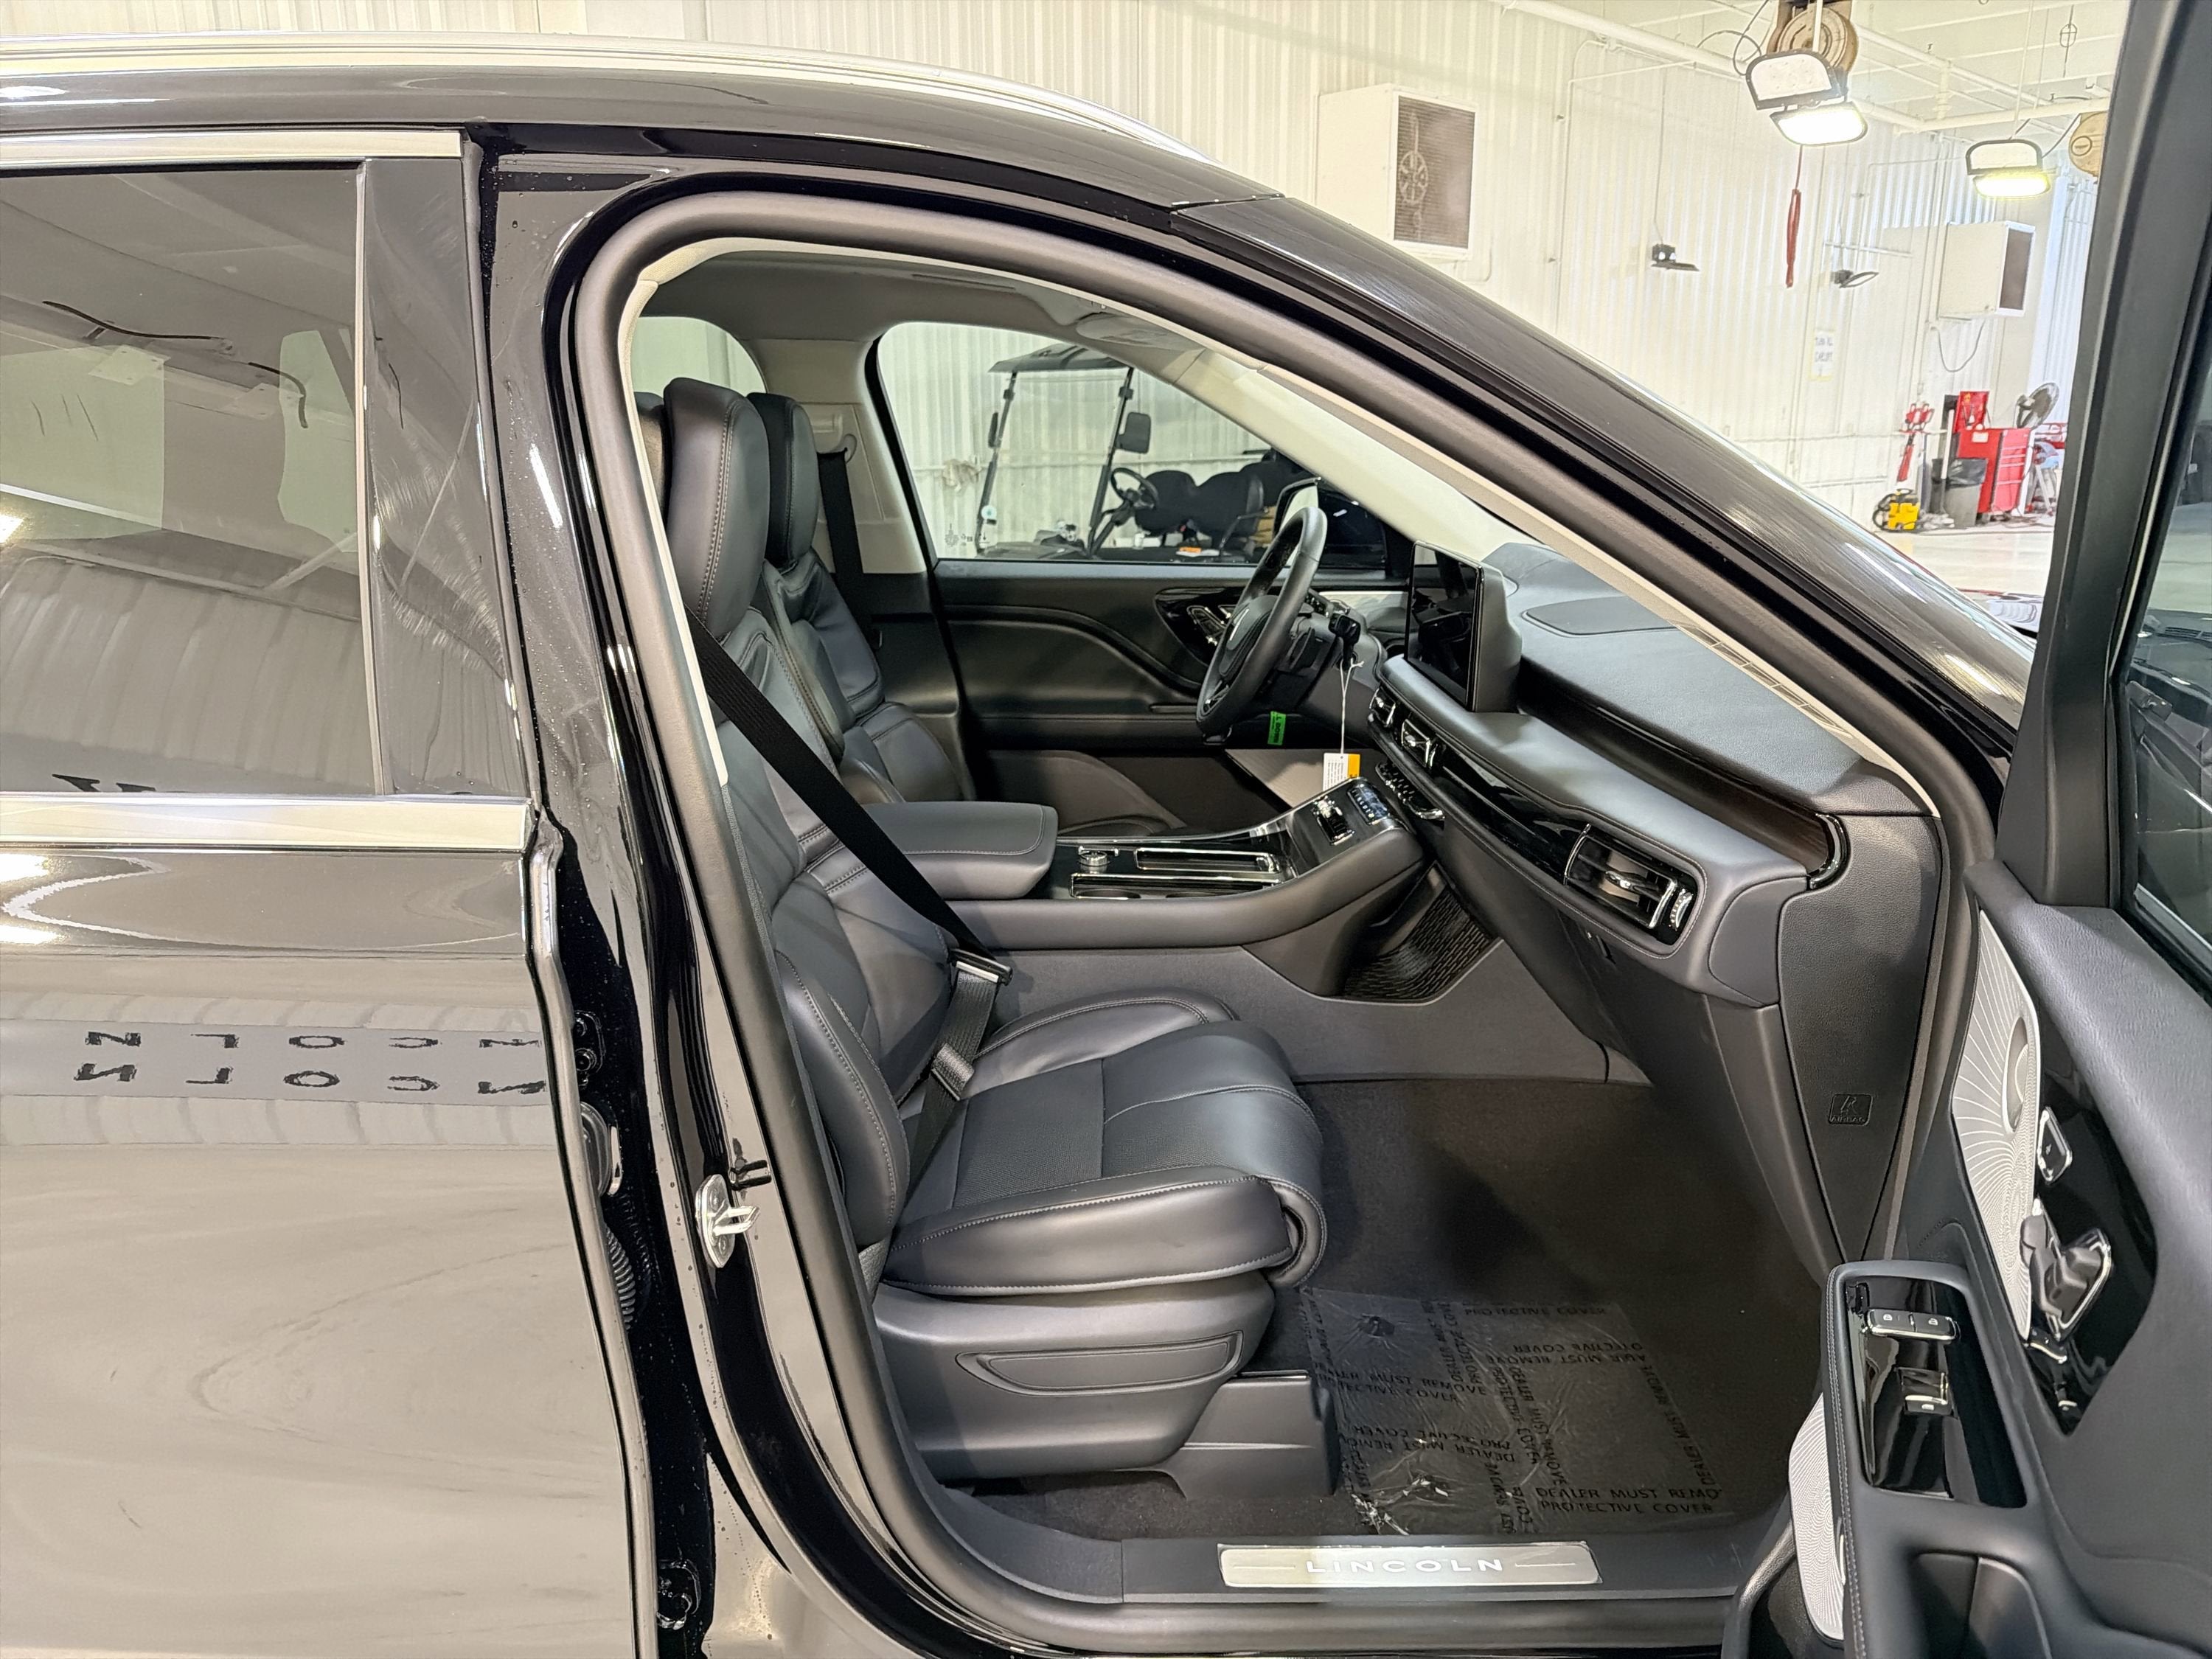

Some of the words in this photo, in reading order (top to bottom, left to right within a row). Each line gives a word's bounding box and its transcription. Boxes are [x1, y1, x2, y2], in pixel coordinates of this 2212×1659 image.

[1535, 1487, 1600, 1499] DEALER
[1610, 1488, 1658, 1499] MUST
[1541, 1501, 1645, 1514] PROTECTIVE
[1652, 1502, 1714, 1514] COVER
[1306, 1559, 1503, 1573] LINCOLN
